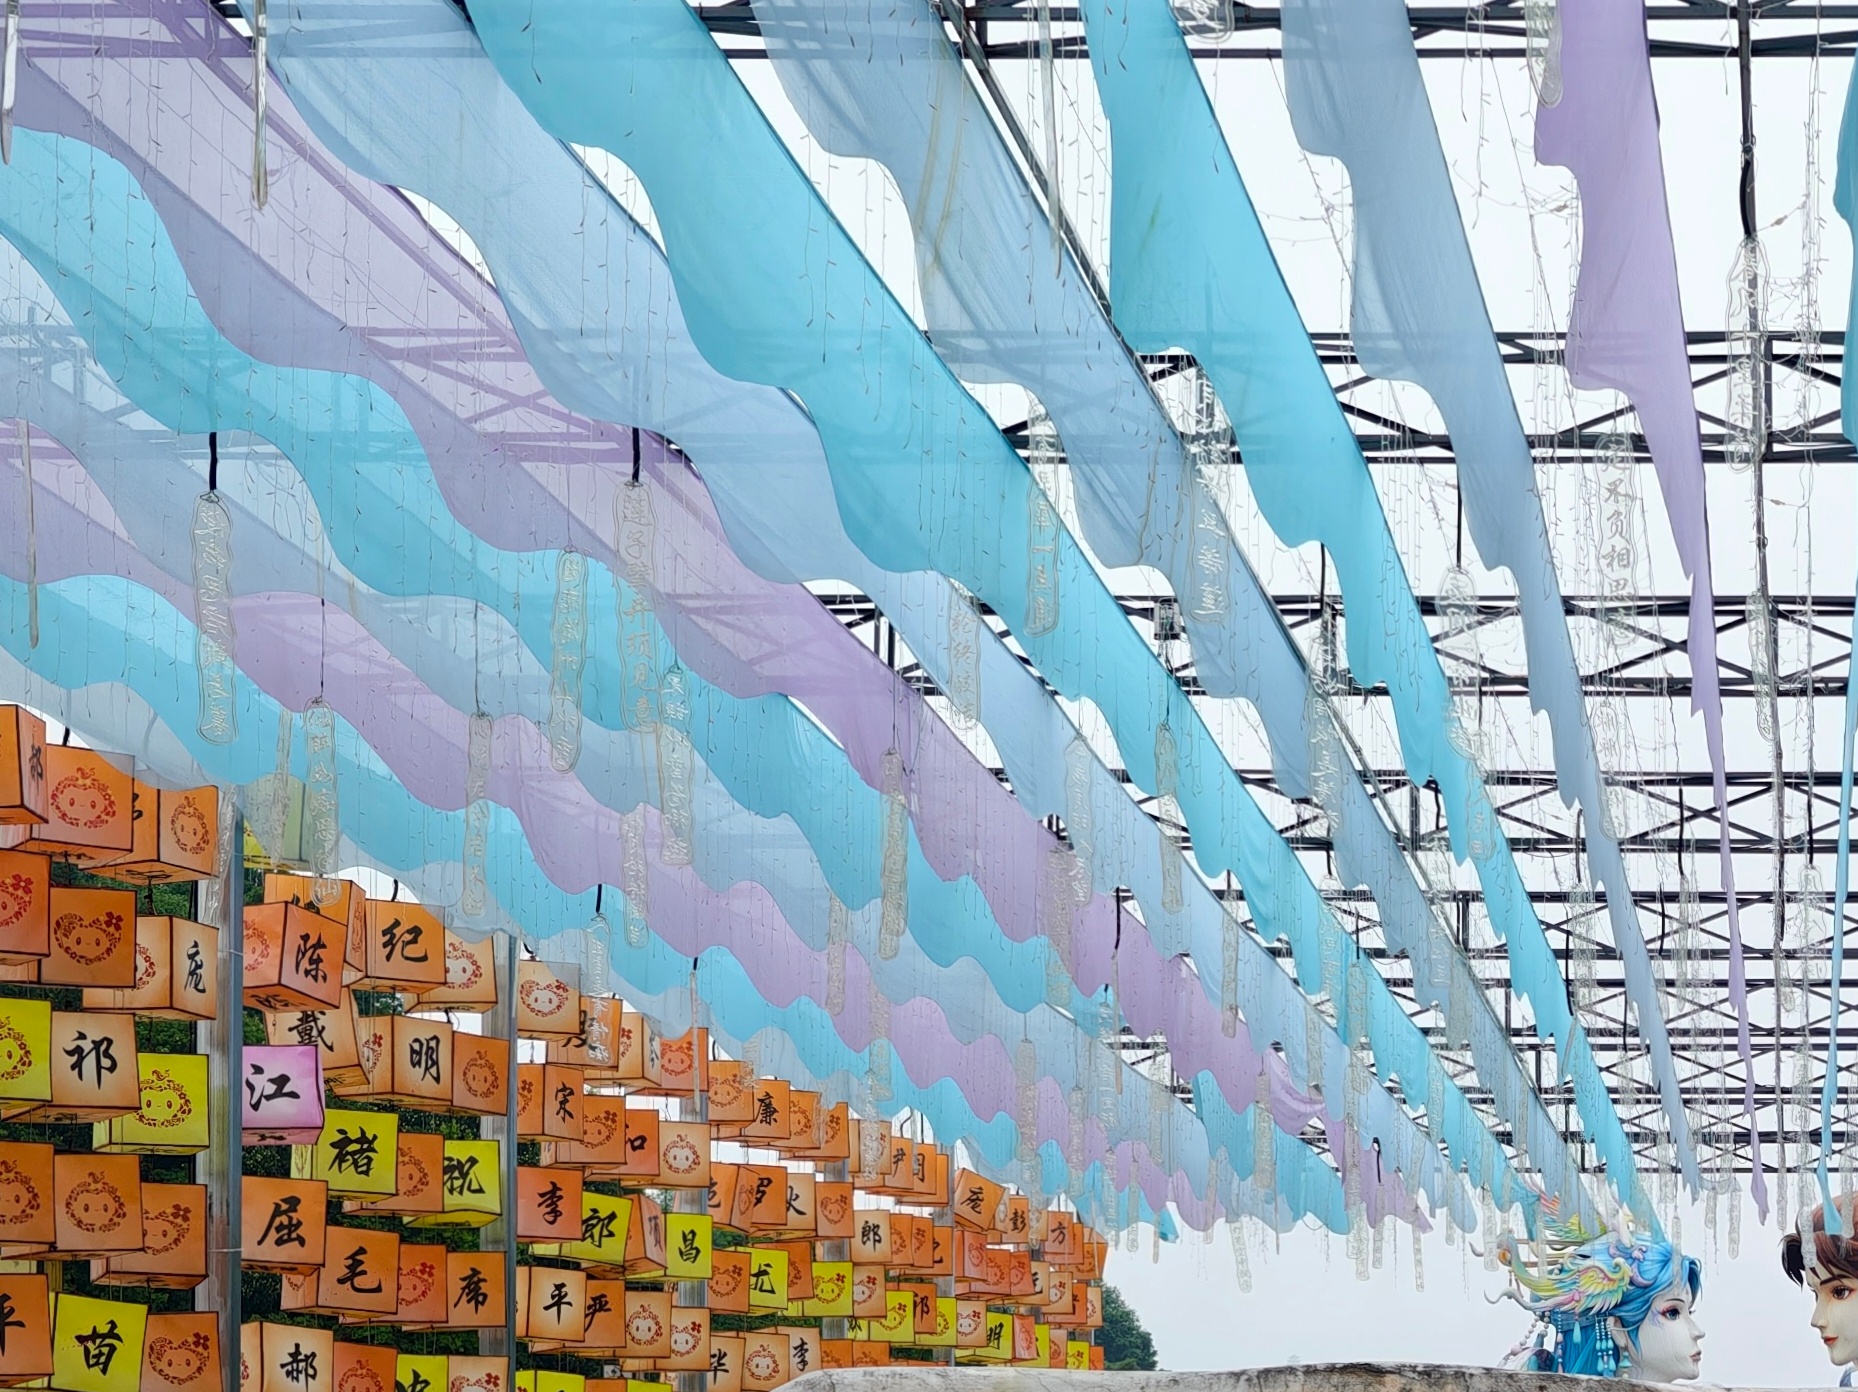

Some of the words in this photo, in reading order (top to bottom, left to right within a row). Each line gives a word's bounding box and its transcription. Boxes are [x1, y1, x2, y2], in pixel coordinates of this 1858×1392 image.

[295, 932, 327, 984] 陈
[381, 918, 428, 963] 纪
[63, 1030, 118, 1089] 祁
[409, 1035, 440, 1084] 明
[245, 1063, 300, 1112] 江
[328, 1126, 378, 1177] 褚
[257, 1195, 306, 1248] 屈
[537, 1181, 564, 1225] 李
[336, 1246, 383, 1294] 毛
[678, 1229, 702, 1264] 昌
[454, 1267, 488, 1315] 席
[543, 1282, 573, 1326] 平
[75, 1319, 123, 1376] 苗
[792, 1337, 809, 1372] 李
